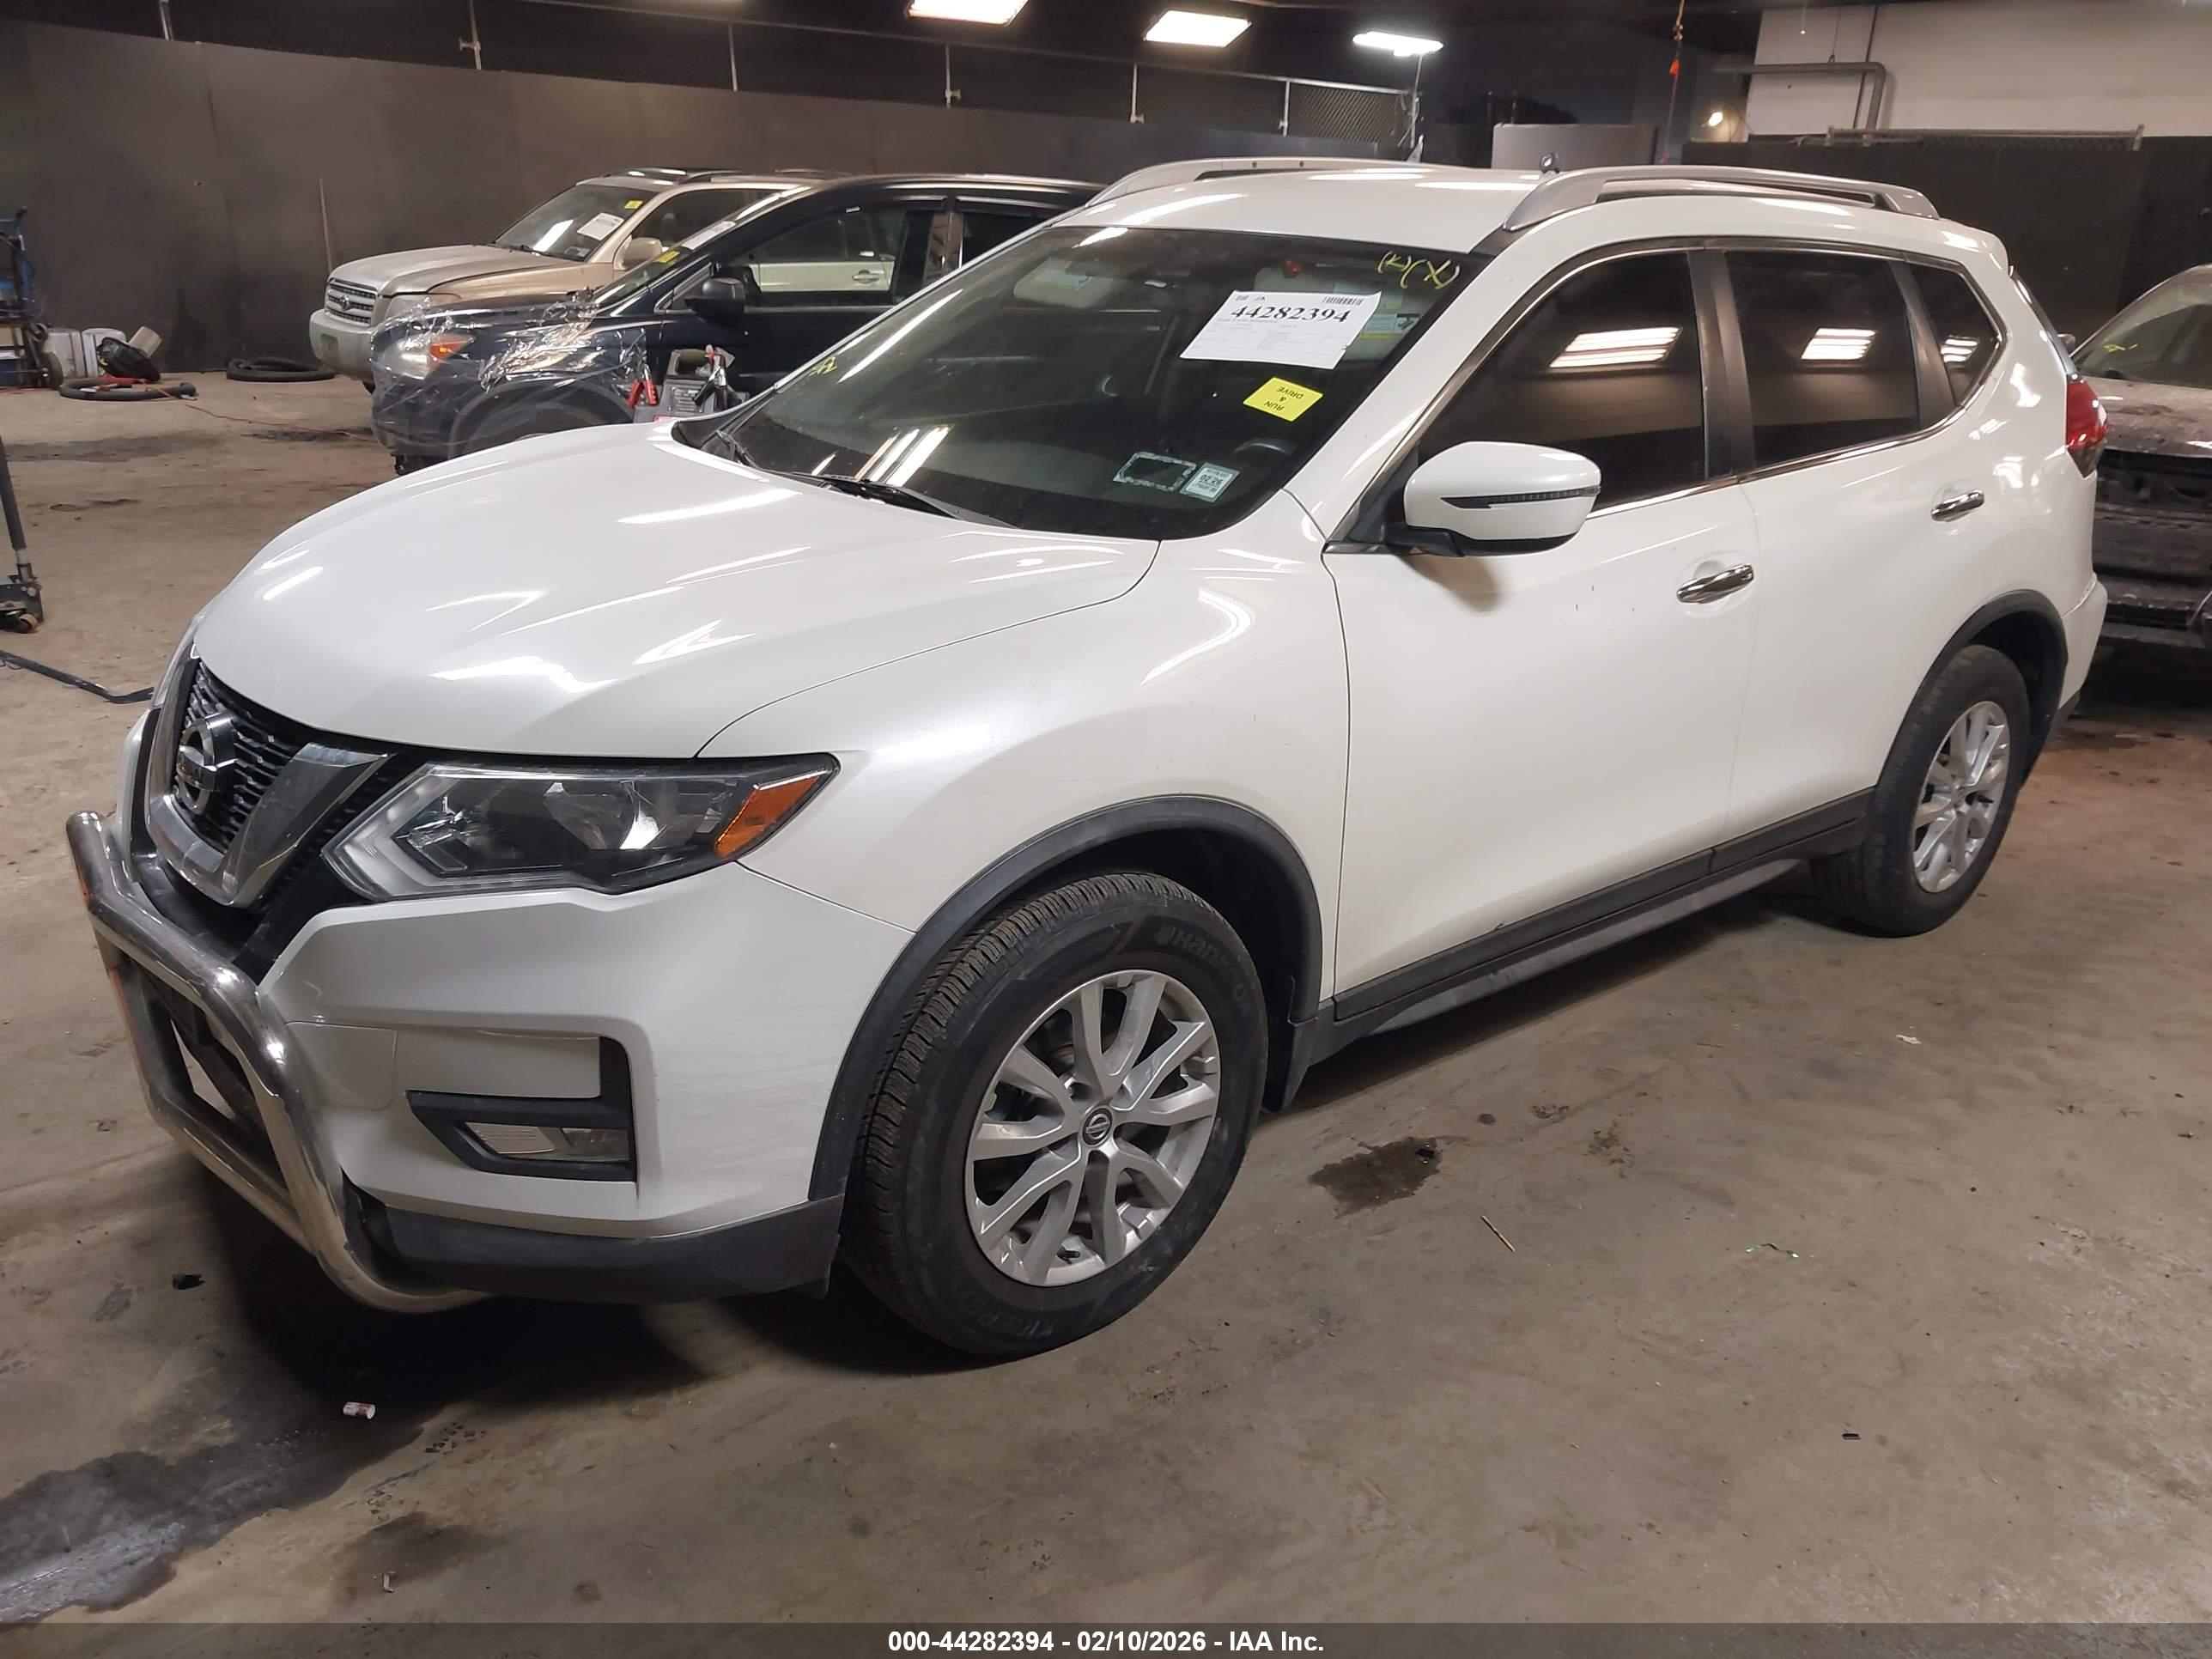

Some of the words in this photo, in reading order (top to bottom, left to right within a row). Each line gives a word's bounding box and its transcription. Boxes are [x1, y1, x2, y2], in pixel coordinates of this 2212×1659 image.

[1231, 305, 1352, 323] 44282394
[1276, 386, 1304, 399] DRIVE
[1263, 400, 1285, 411] RUN
[1212, 477, 1224, 485] 26
